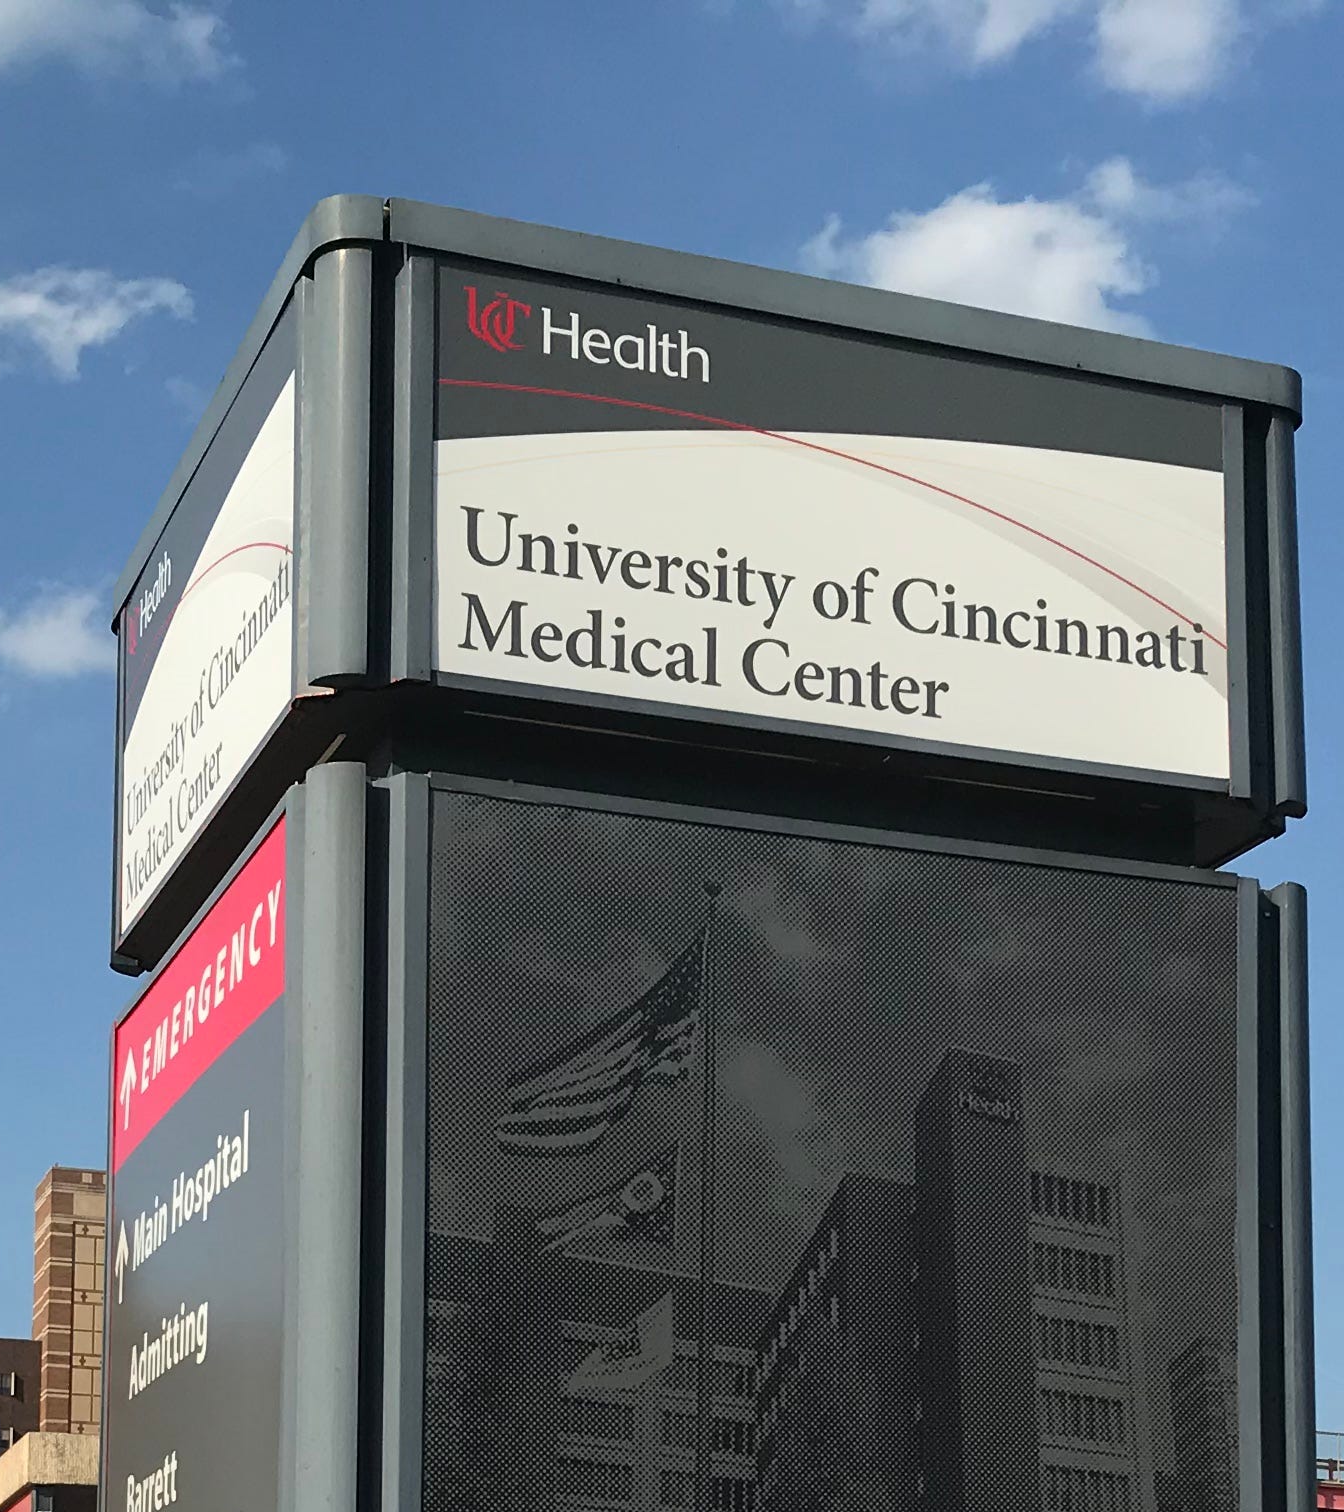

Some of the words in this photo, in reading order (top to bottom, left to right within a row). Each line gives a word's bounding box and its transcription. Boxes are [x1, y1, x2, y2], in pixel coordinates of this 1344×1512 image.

[542, 308, 711, 383] Health
[140, 551, 171, 637] Health
[459, 593, 721, 686] Medical
[743, 638, 949, 718] Center
[461, 506, 795, 627] University
[812, 568, 879, 626] of
[893, 578, 1208, 675] Cincinnati
[125, 719, 188, 837] University
[190, 667, 207, 737] of
[207, 544, 292, 712] Cincinnati
[125, 785, 174, 911] Medical
[176, 741, 223, 836] Center
[140, 880, 281, 1095] EMERGENCY
[132, 1196, 168, 1271] Main
[171, 1109, 250, 1234] Hospital
[128, 1301, 209, 1400] Admitting
